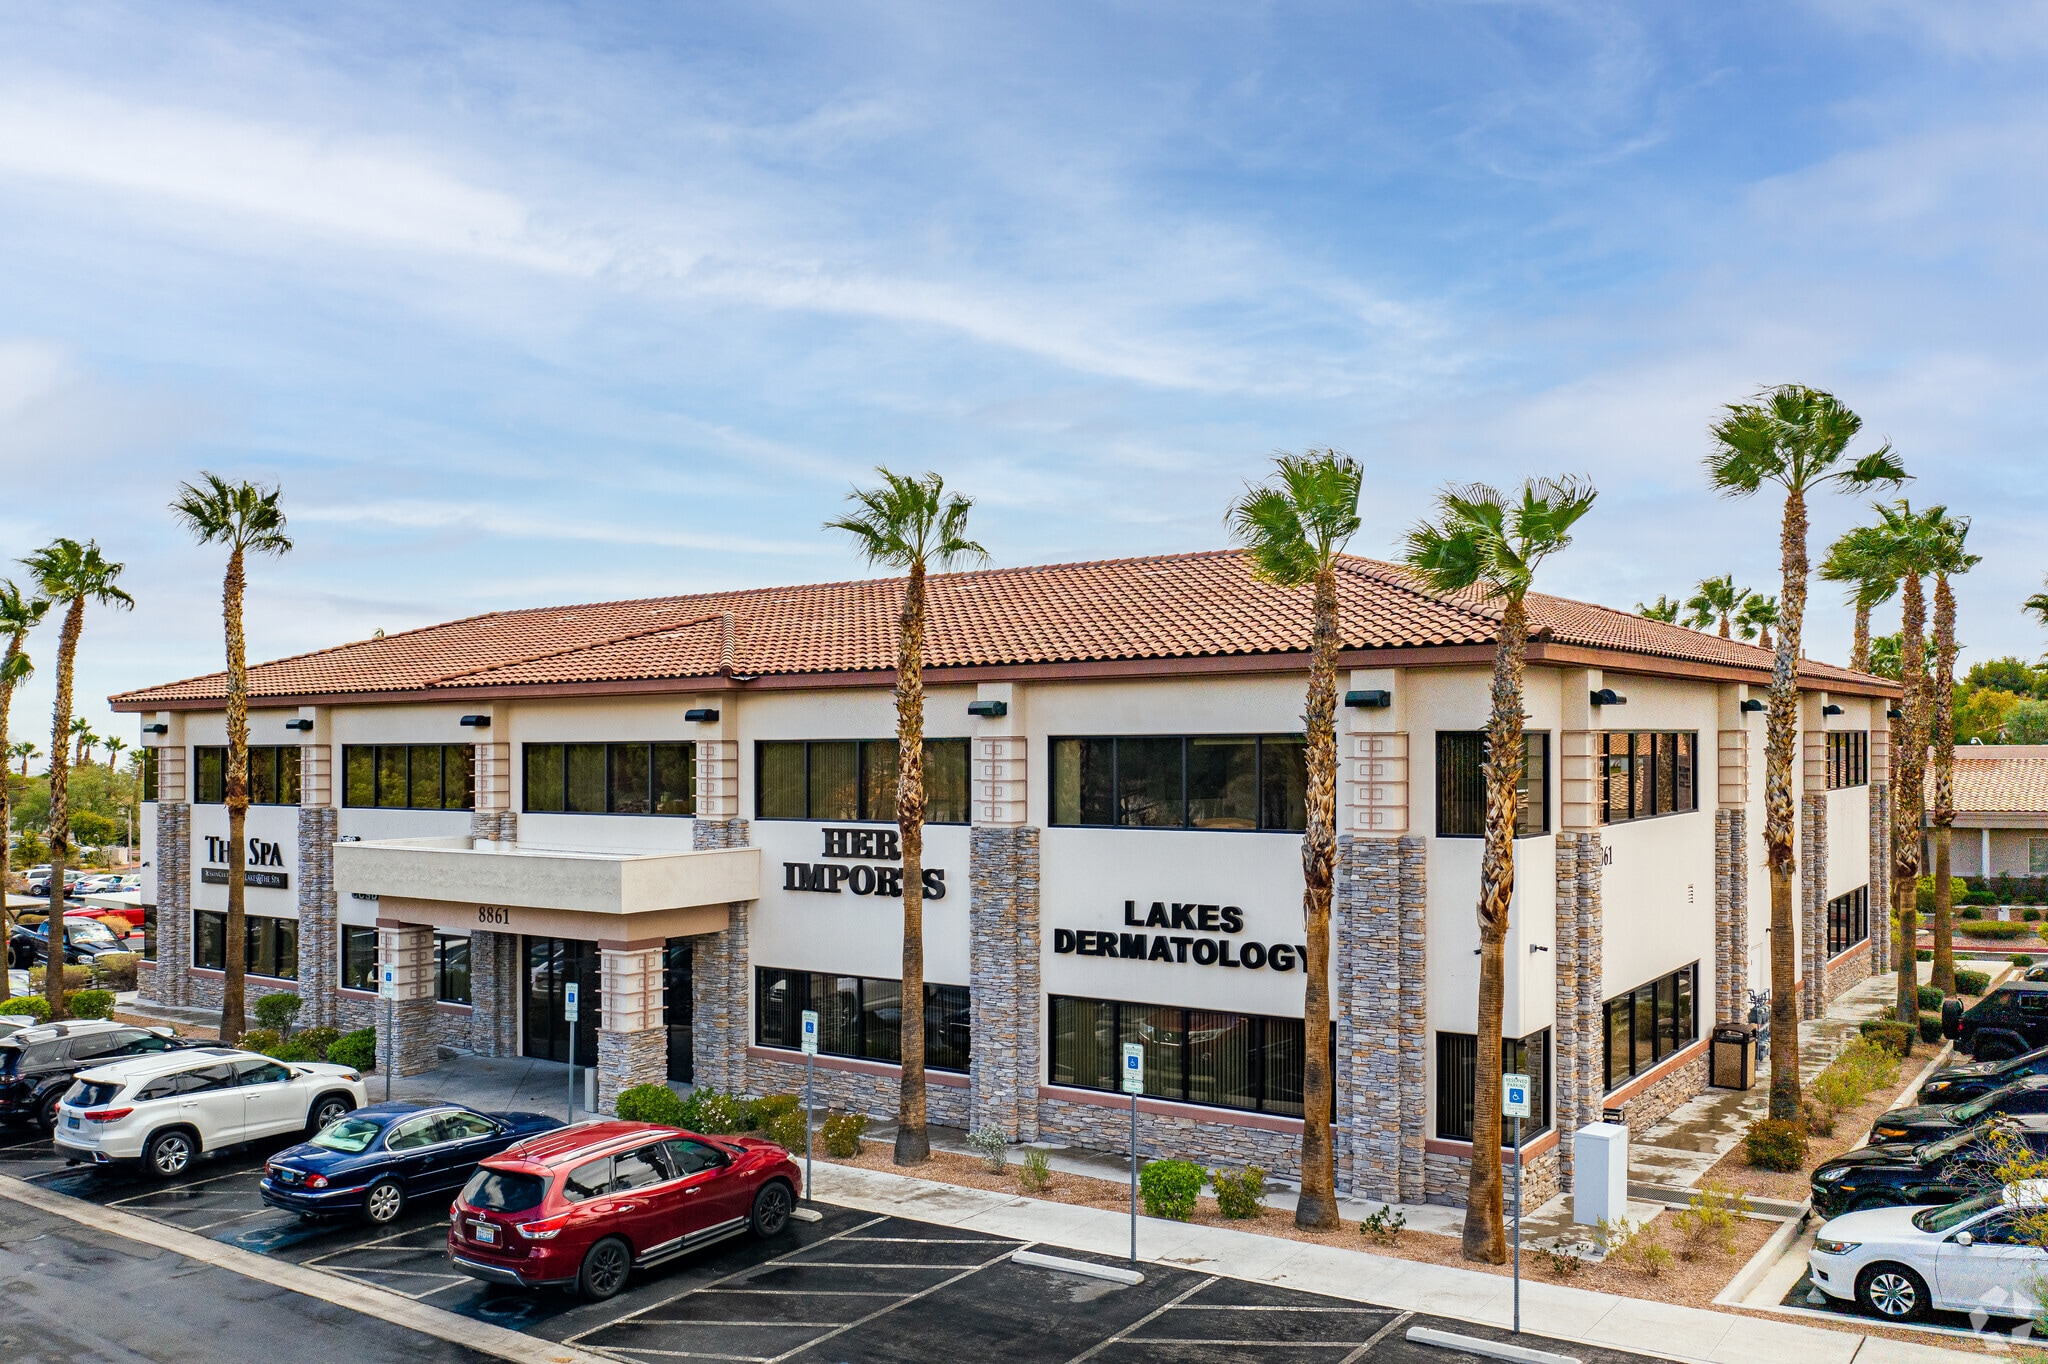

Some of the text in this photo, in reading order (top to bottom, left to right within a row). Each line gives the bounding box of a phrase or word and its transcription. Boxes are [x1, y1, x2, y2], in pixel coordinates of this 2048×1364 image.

[205, 835, 230, 863] TH
[822, 828, 902, 860] HER
[783, 862, 946, 900] IMPORS
[478, 906, 510, 925] 8861
[1124, 900, 1244, 934] LAKES
